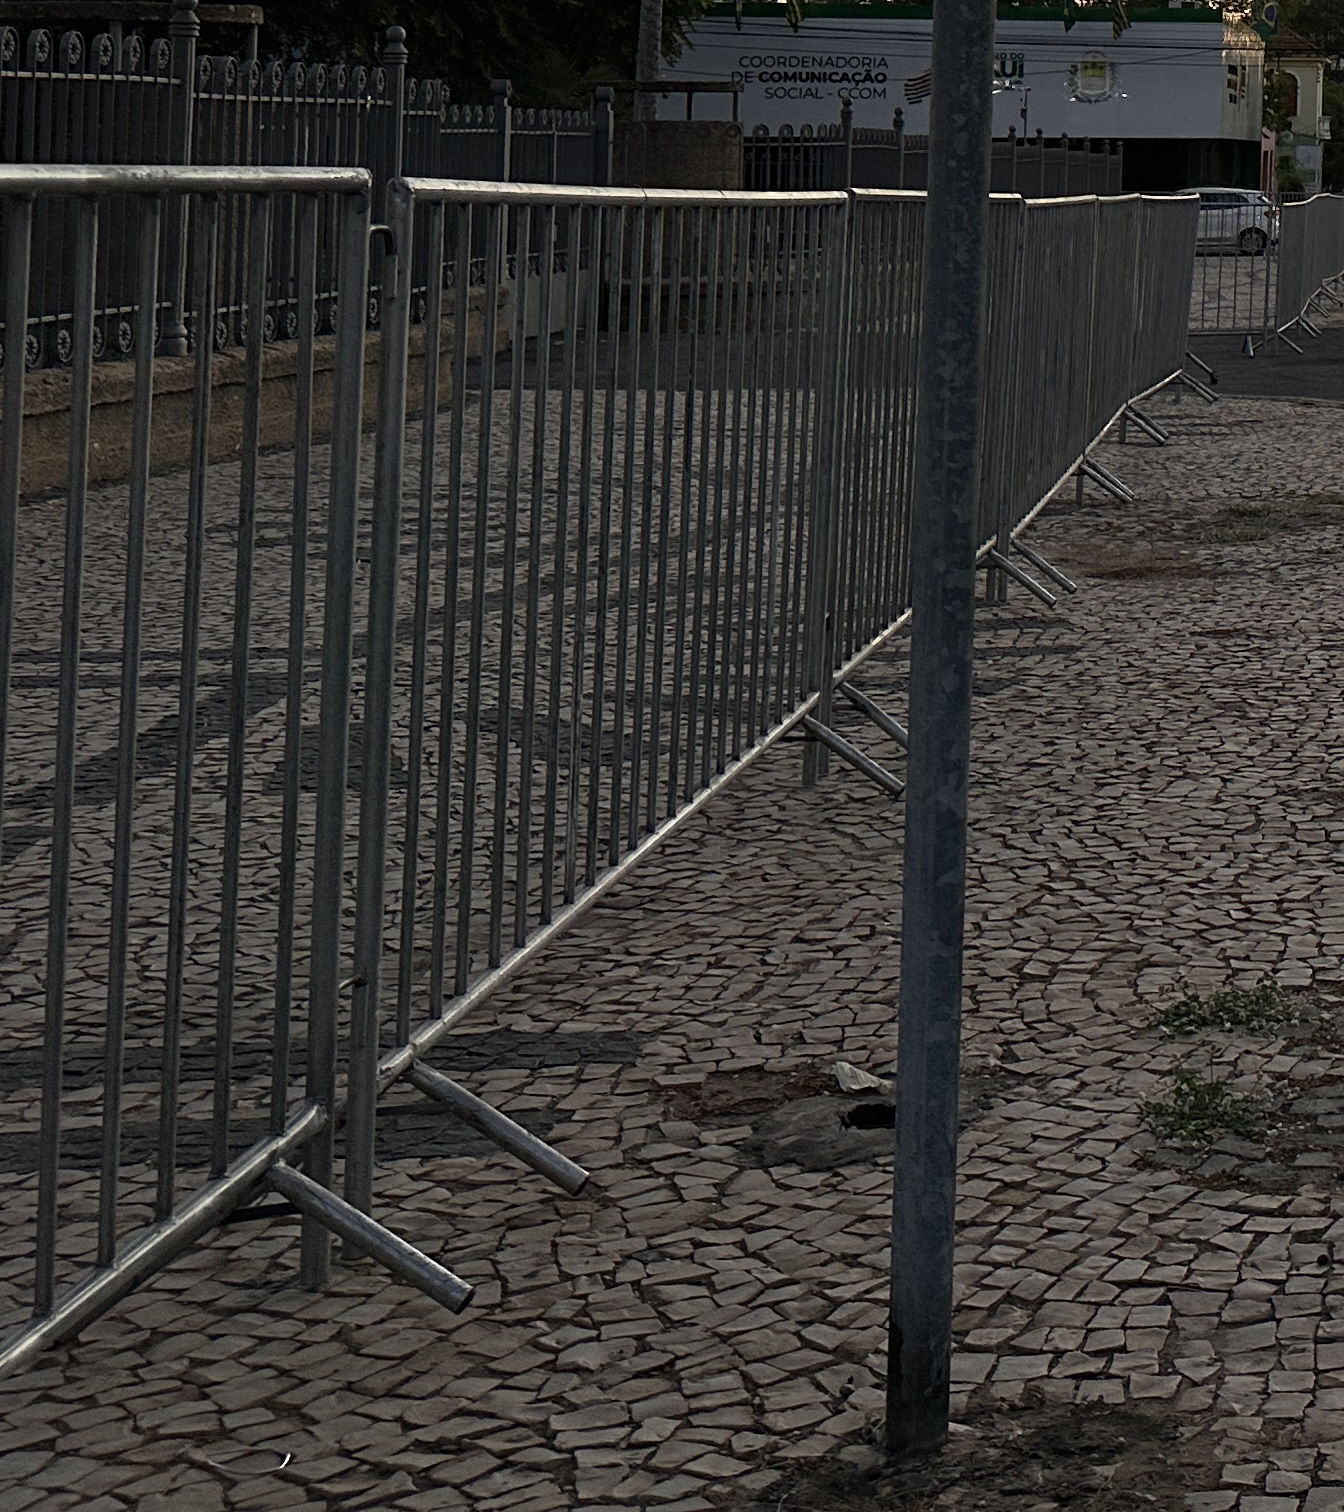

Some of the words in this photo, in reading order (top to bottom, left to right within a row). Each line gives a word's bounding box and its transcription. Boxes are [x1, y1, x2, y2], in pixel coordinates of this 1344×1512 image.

[739, 55, 889, 68] COORDENADORIA
[732, 71, 754, 83] DE
[759, 69, 887, 86] COMUNICAÇÃO
[764, 86, 824, 99] SOCIAL
[838, 87, 886, 99] CCOM
